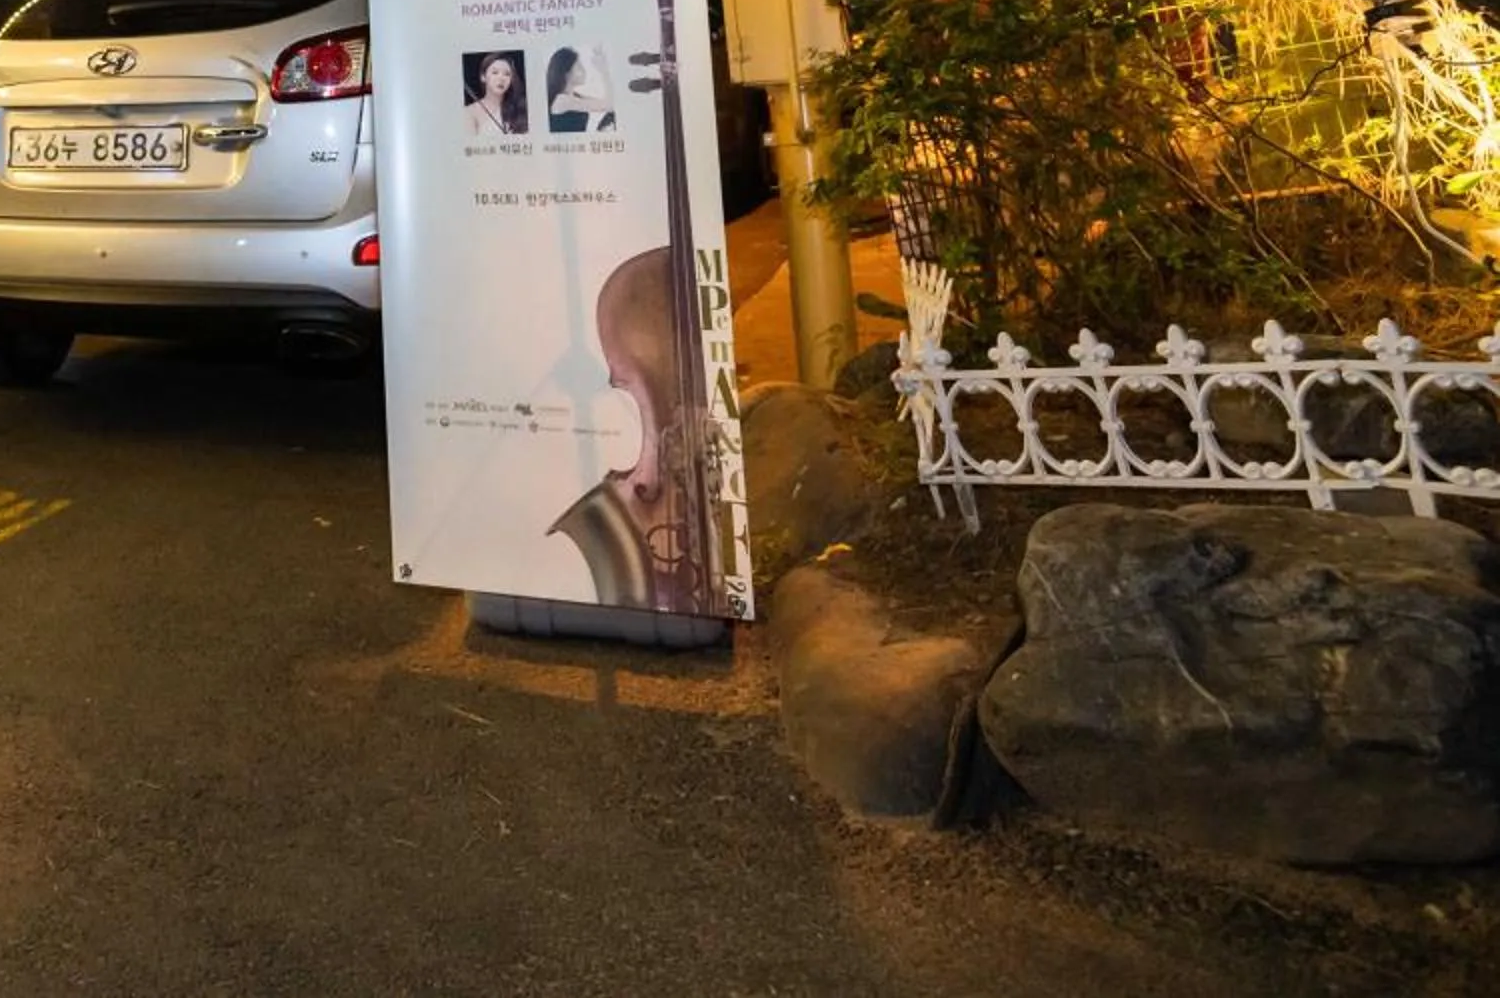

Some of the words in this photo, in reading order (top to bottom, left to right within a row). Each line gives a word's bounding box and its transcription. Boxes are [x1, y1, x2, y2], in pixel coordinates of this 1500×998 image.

[461, 0, 535, 17] ROMANTIC
[492, 18, 530, 35] 로맨틱
[535, 15, 575, 32] 판타지
[26, 133, 78, 162] 36누
[93, 133, 167, 162] 8586
